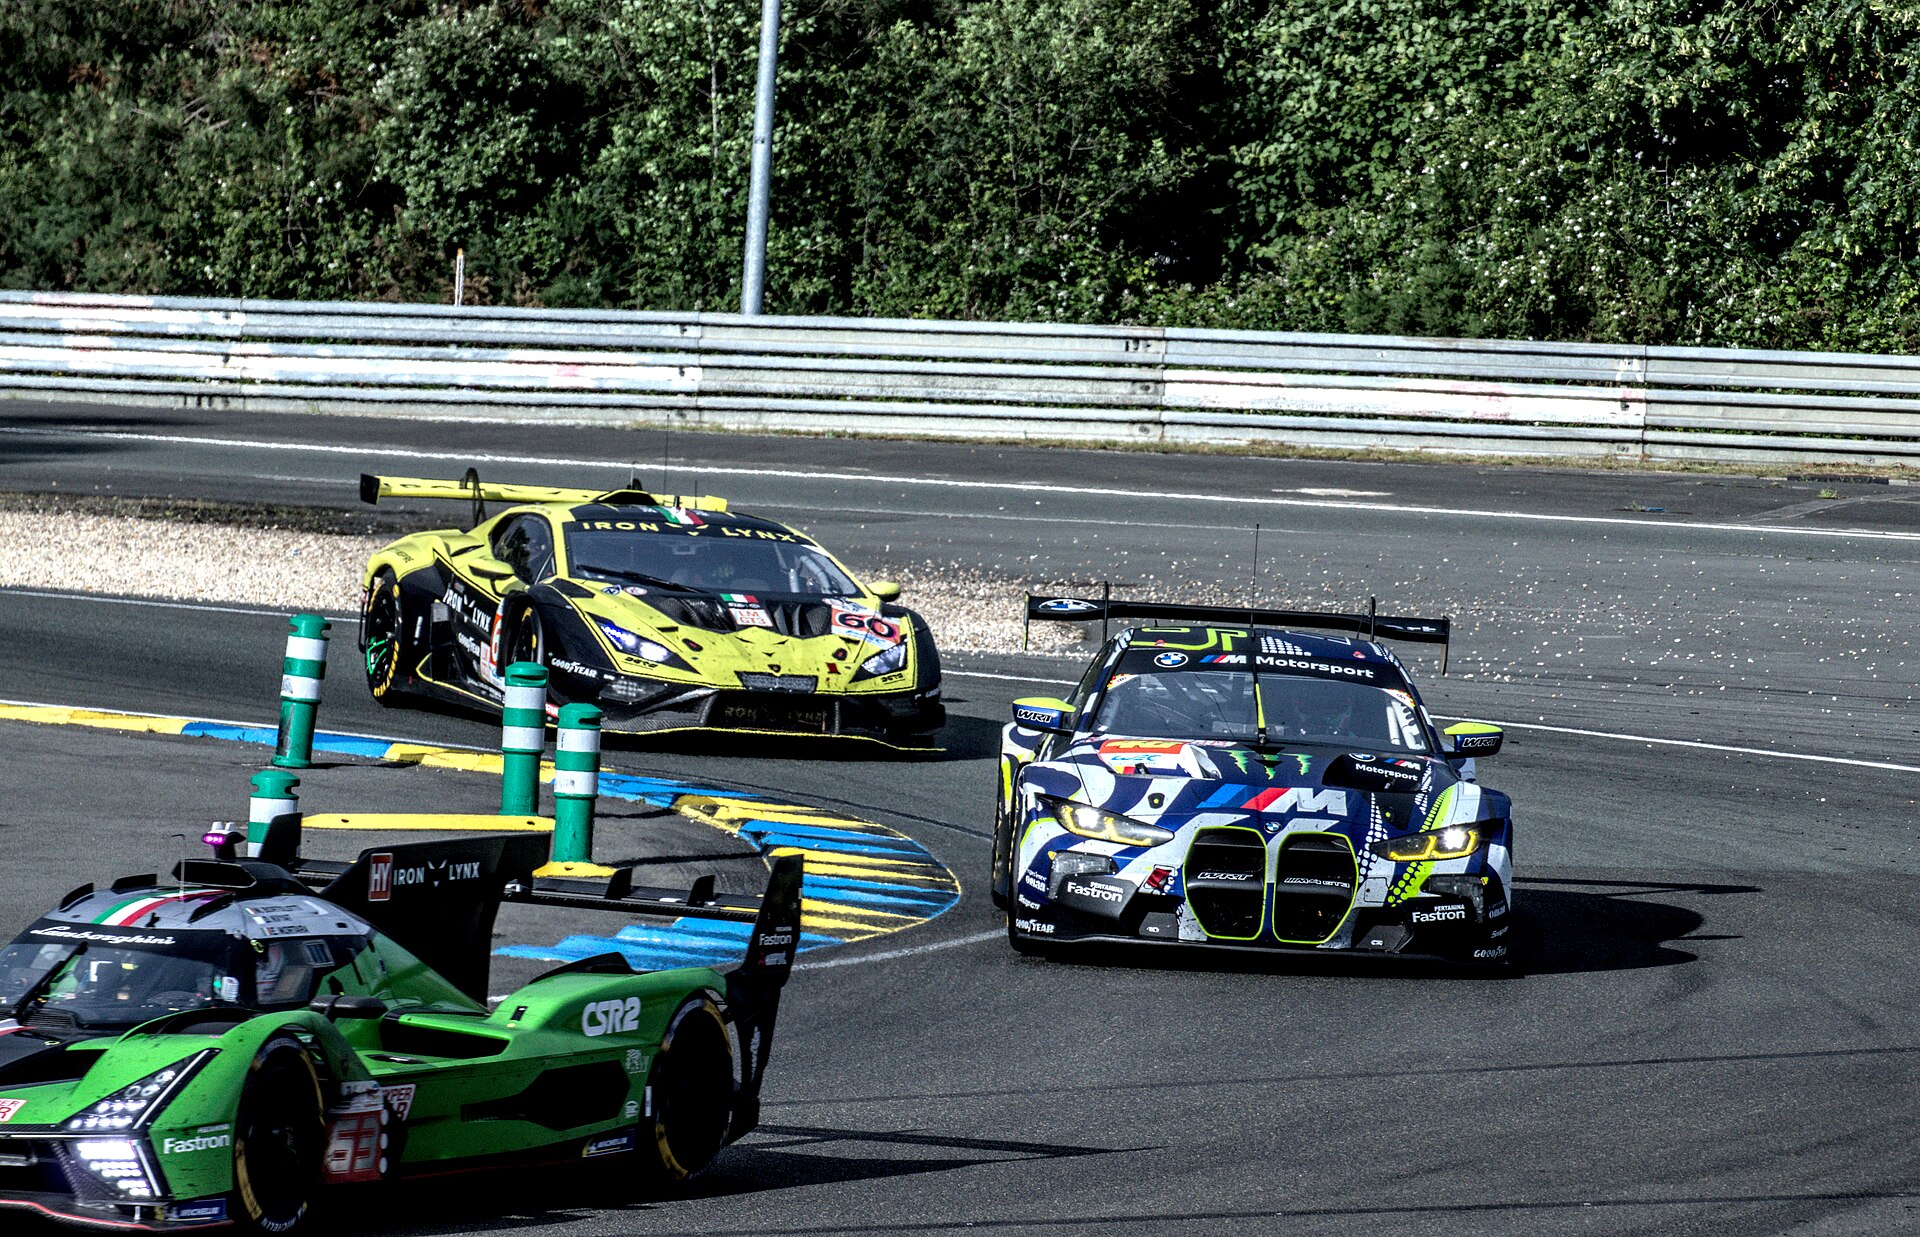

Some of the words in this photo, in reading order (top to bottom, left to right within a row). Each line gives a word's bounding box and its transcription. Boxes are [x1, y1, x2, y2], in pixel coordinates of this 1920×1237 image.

[582, 521, 660, 532] IRON
[721, 527, 796, 542] LYNX
[443, 588, 462, 612] IRON
[472, 607, 491, 632] LYNX
[834, 611, 896, 638] 60
[551, 657, 598, 679] GOODYEAR
[1256, 655, 1374, 679] Motorsport
[1017, 709, 1051, 723] WRT
[1462, 736, 1500, 748] WRT
[1355, 763, 1419, 781] Motorsport
[370, 863, 391, 892] HY
[393, 867, 425, 886] IRON
[448, 862, 480, 881] LYNX
[1067, 882, 1123, 902] Fastron
[1412, 909, 1466, 923] Fastron
[1434, 904, 1465, 912] PERTAMINA
[30, 926, 176, 945] Lamborghini
[759, 933, 792, 945] Fastron
[582, 997, 641, 1037] CSR2
[163, 1134, 230, 1154] Fastron
[324, 1117, 380, 1174] 63
